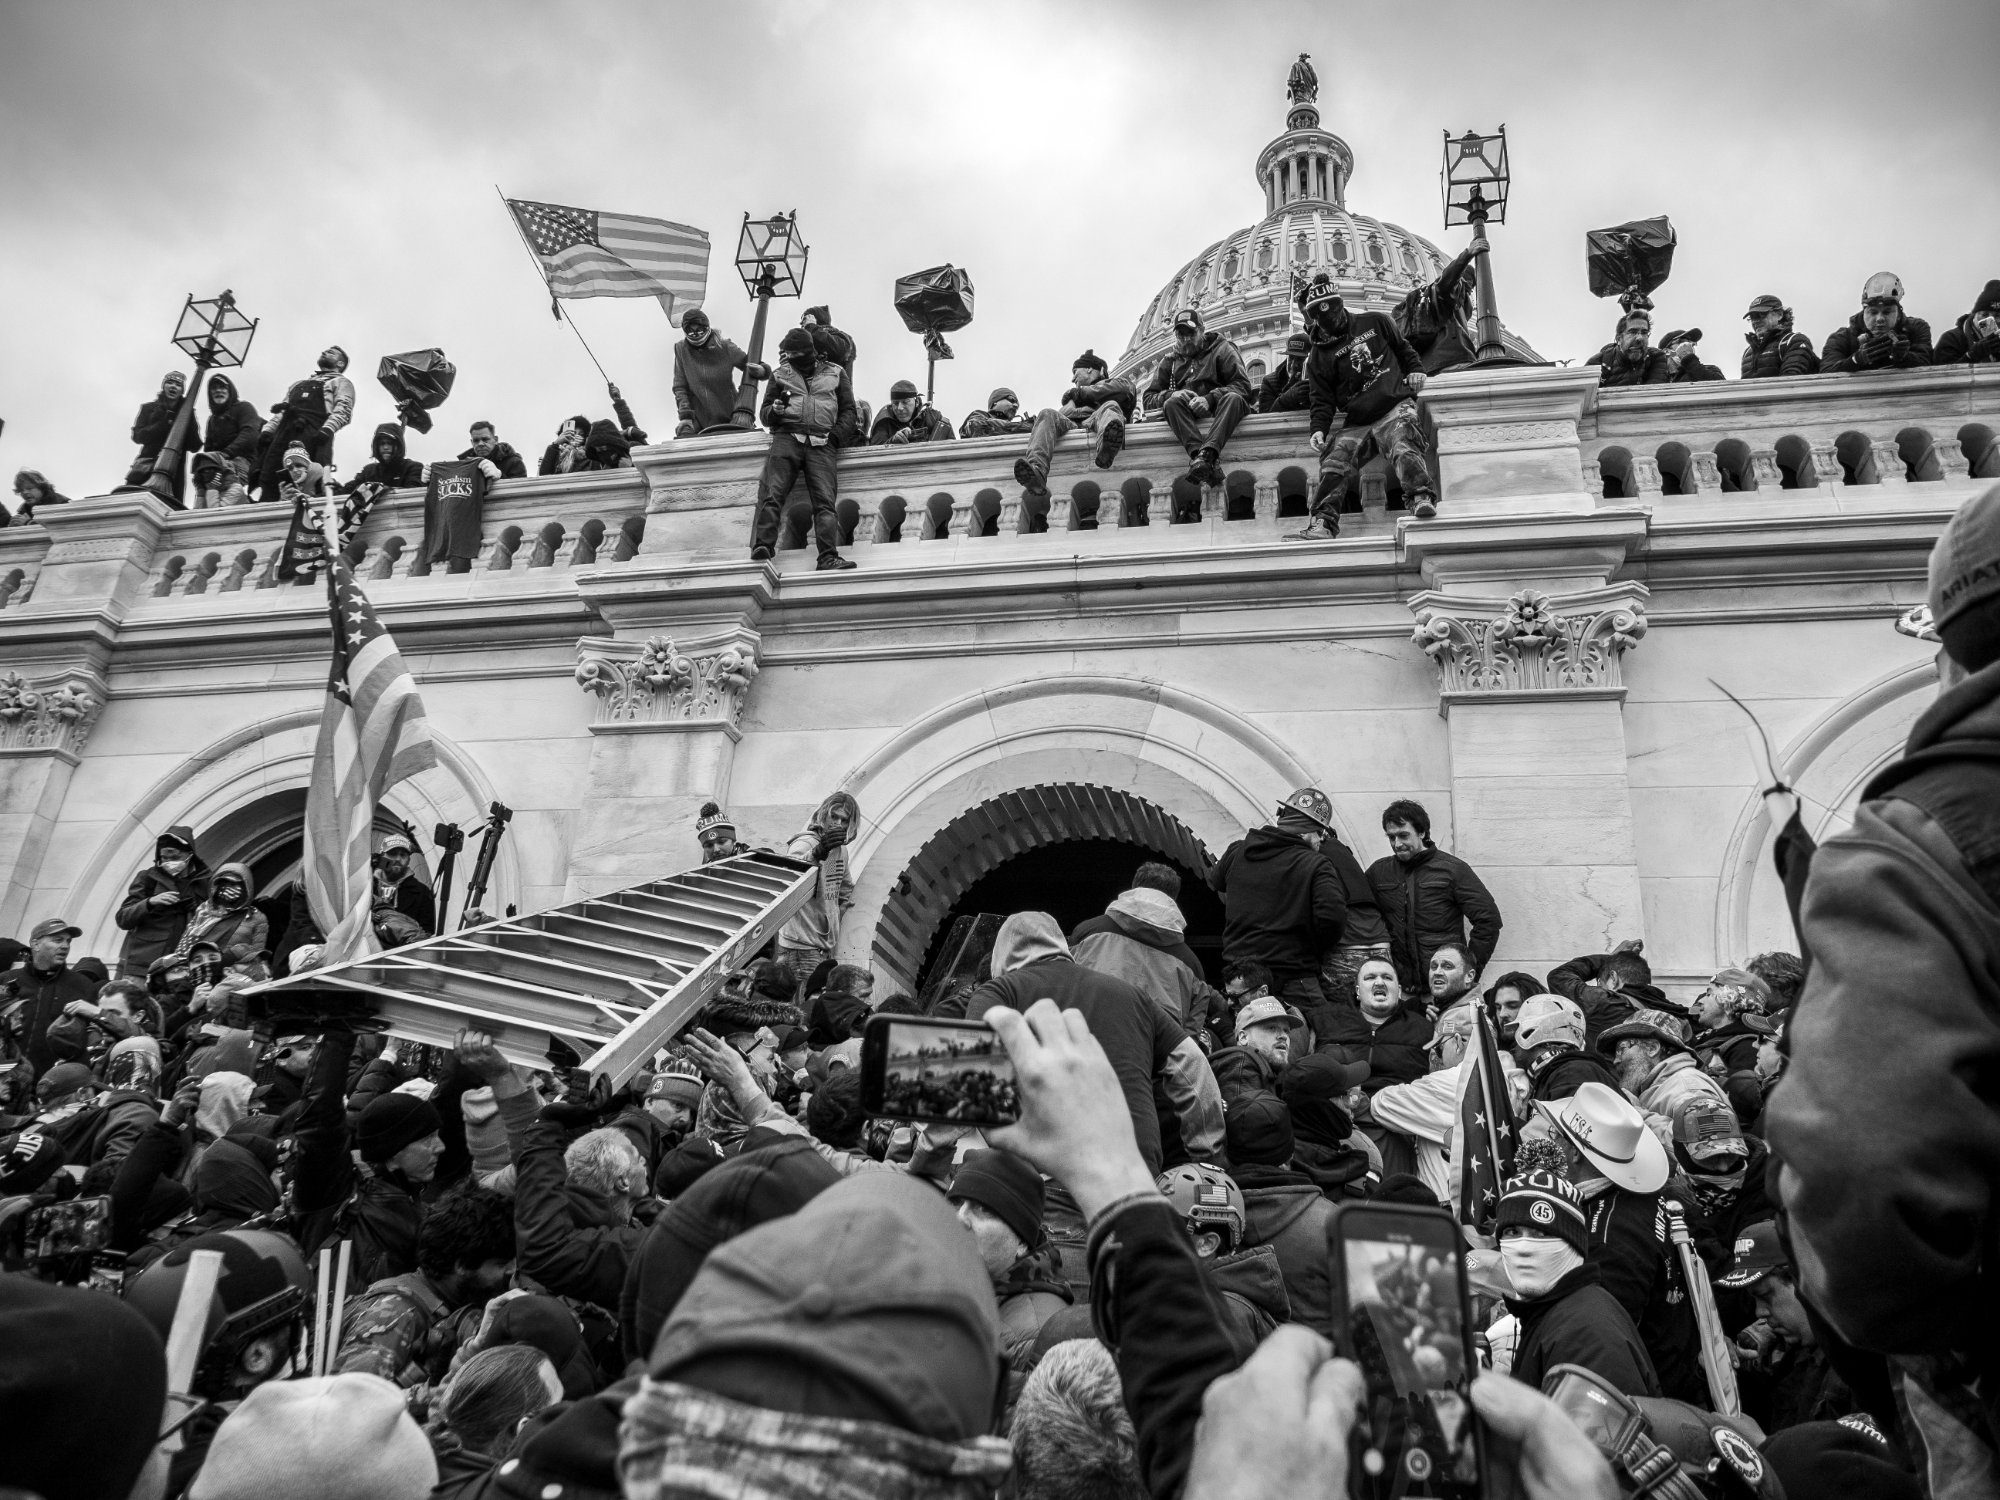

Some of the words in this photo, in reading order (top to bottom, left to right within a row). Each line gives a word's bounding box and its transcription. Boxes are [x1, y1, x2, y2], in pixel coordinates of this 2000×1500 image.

[437, 482, 473, 498] SUCKS
[699, 812, 729, 829] RUM
[1569, 1112, 1593, 1139] USA
[1535, 1205, 1550, 1219] 45
[1731, 1270, 1764, 1287] PRESIDENT
